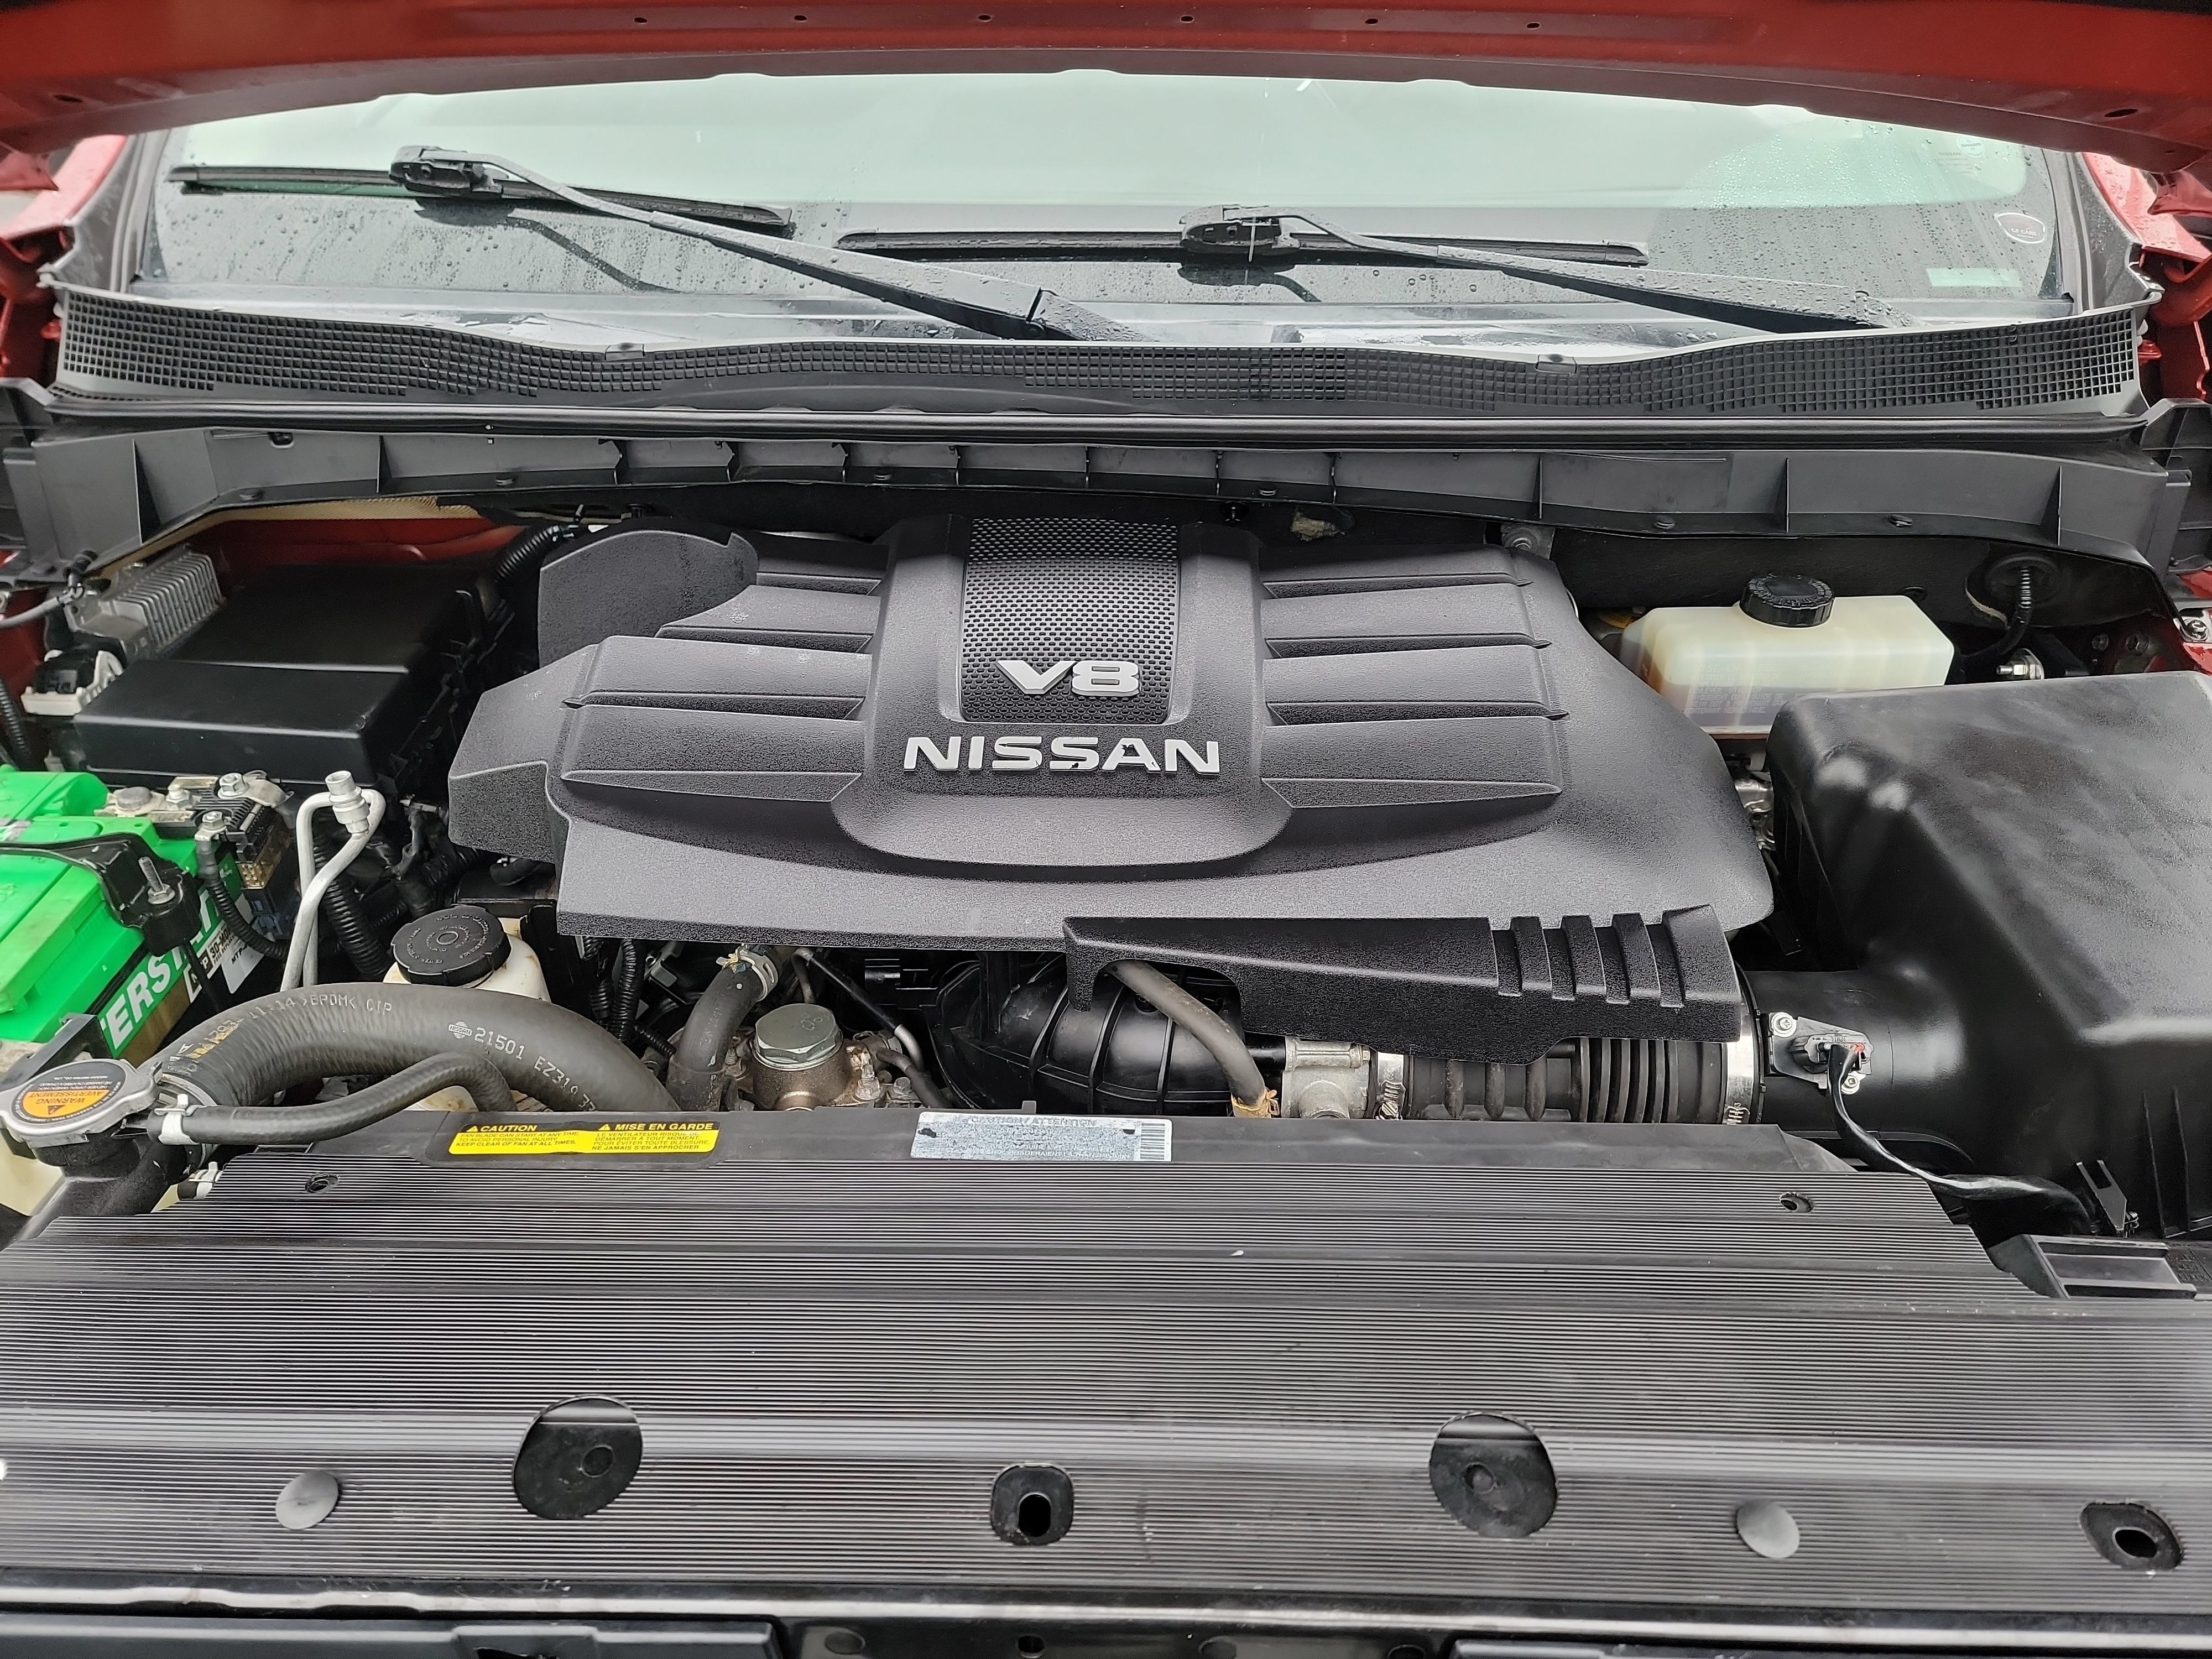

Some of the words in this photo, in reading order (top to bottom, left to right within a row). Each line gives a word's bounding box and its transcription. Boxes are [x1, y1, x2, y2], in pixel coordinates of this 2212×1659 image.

[997, 660, 1141, 697] V8
[904, 736, 1221, 774] NISSAN
[474, 1027, 525, 1060] 21501
